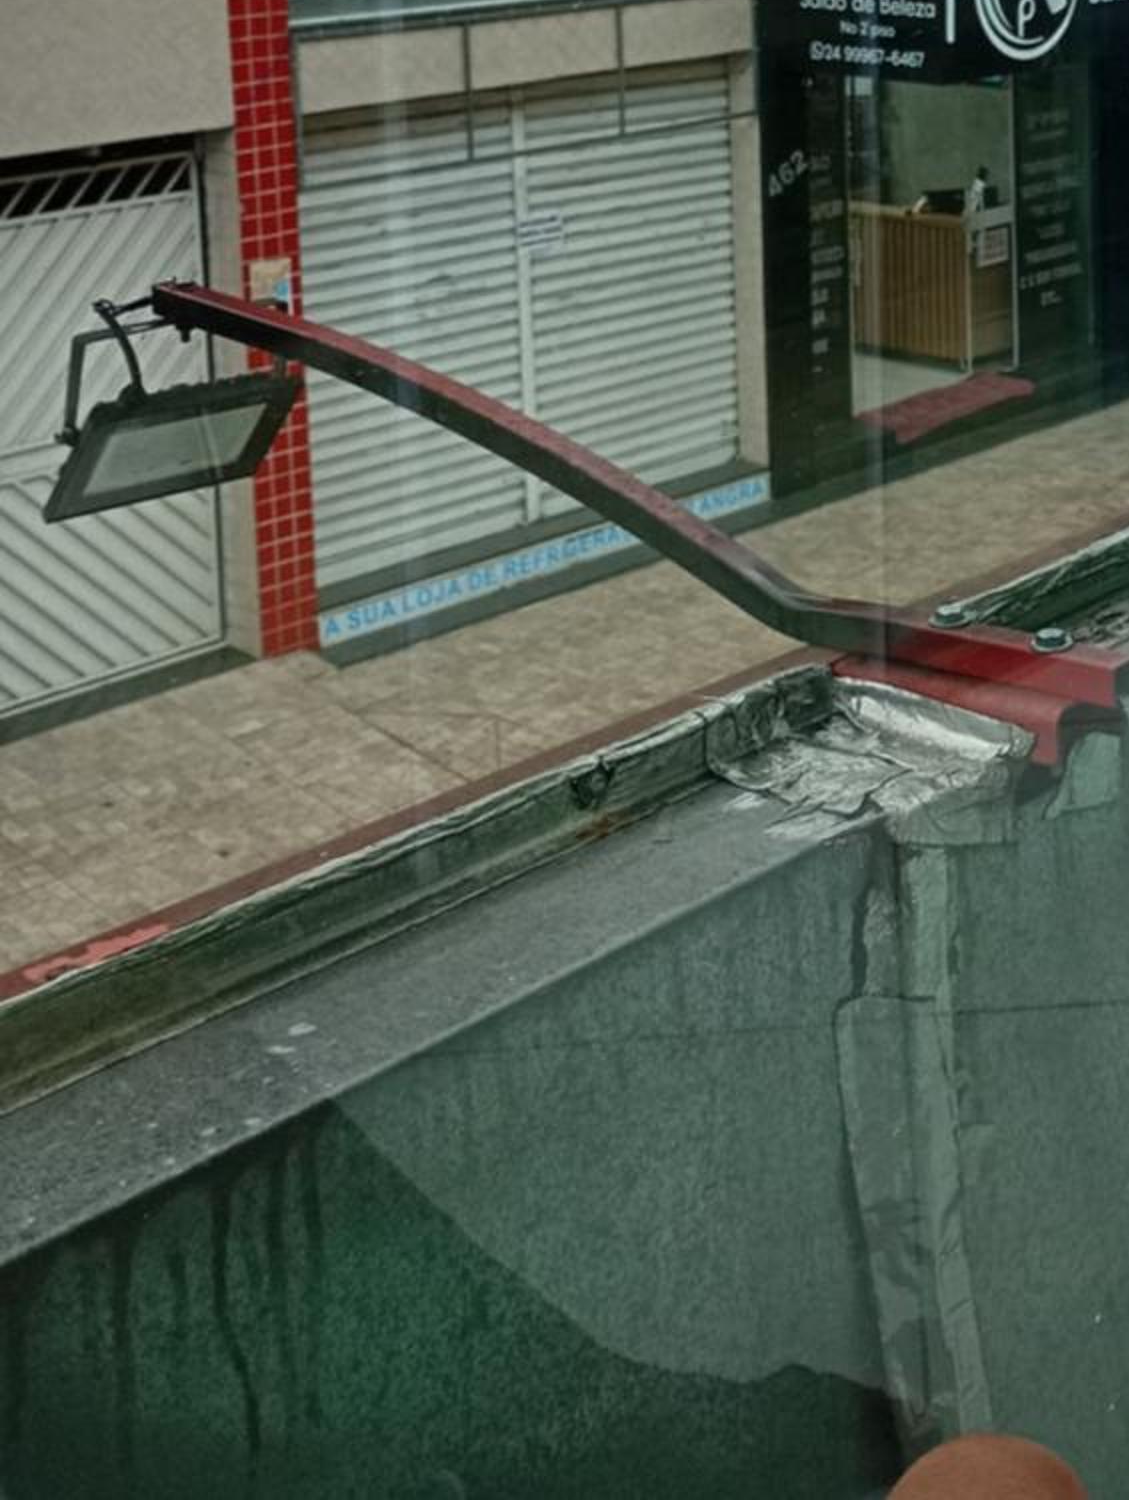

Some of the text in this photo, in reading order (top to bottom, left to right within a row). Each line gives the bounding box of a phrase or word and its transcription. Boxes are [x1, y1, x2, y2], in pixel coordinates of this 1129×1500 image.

[768, 150, 808, 197] 462
[325, 477, 765, 638] A SUA LOJA DE REFRIGERA ANGRA
